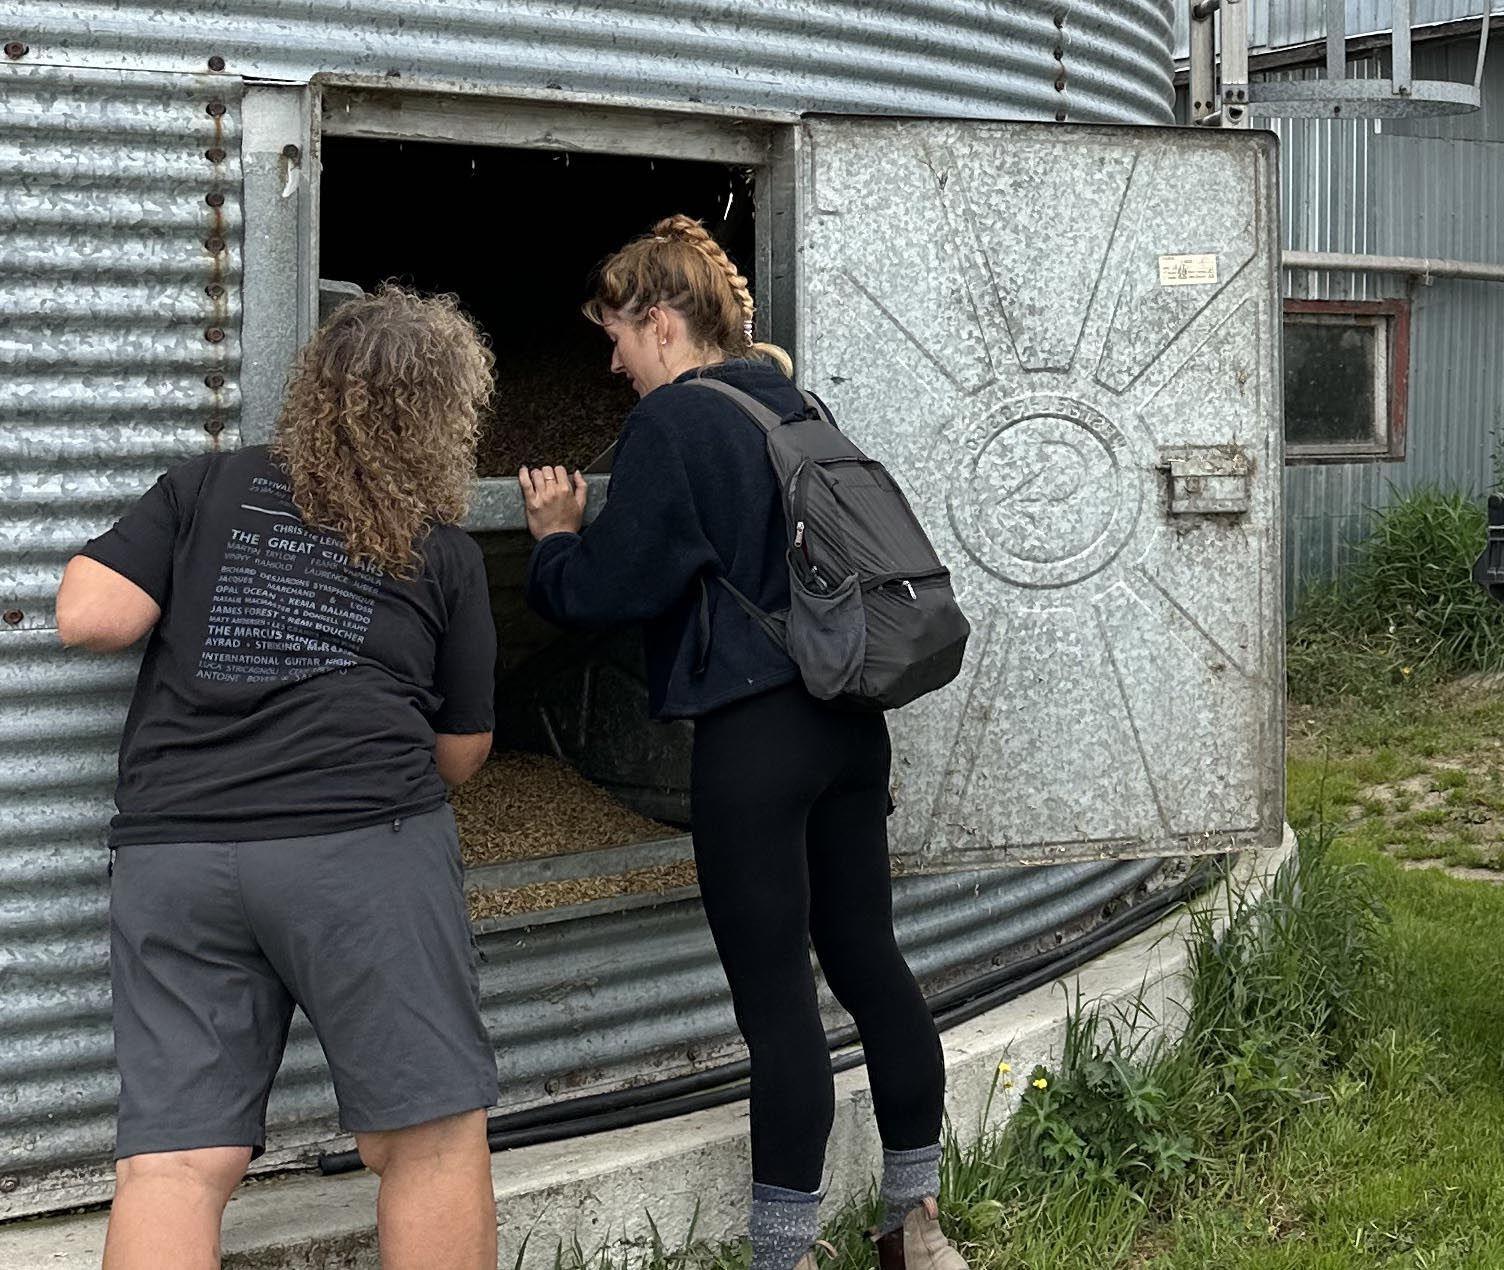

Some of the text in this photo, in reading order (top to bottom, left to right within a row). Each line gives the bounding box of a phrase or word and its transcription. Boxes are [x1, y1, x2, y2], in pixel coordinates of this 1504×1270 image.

[231, 528, 260, 545] THE
[267, 537, 315, 555] GREAT
[215, 585, 239, 594] OPAL
[243, 587, 277, 600] OCEAN
[208, 625, 231, 636] THE
[234, 626, 283, 640] MARCUS
[210, 605, 242, 615] JAMES
[244, 606, 279, 619] FOREST
[315, 622, 365, 645] BOUCHER
[205, 637, 241, 648] AYRAD
[201, 651, 280, 666] INTERNATIONAL
[284, 656, 321, 667] GUITAR
